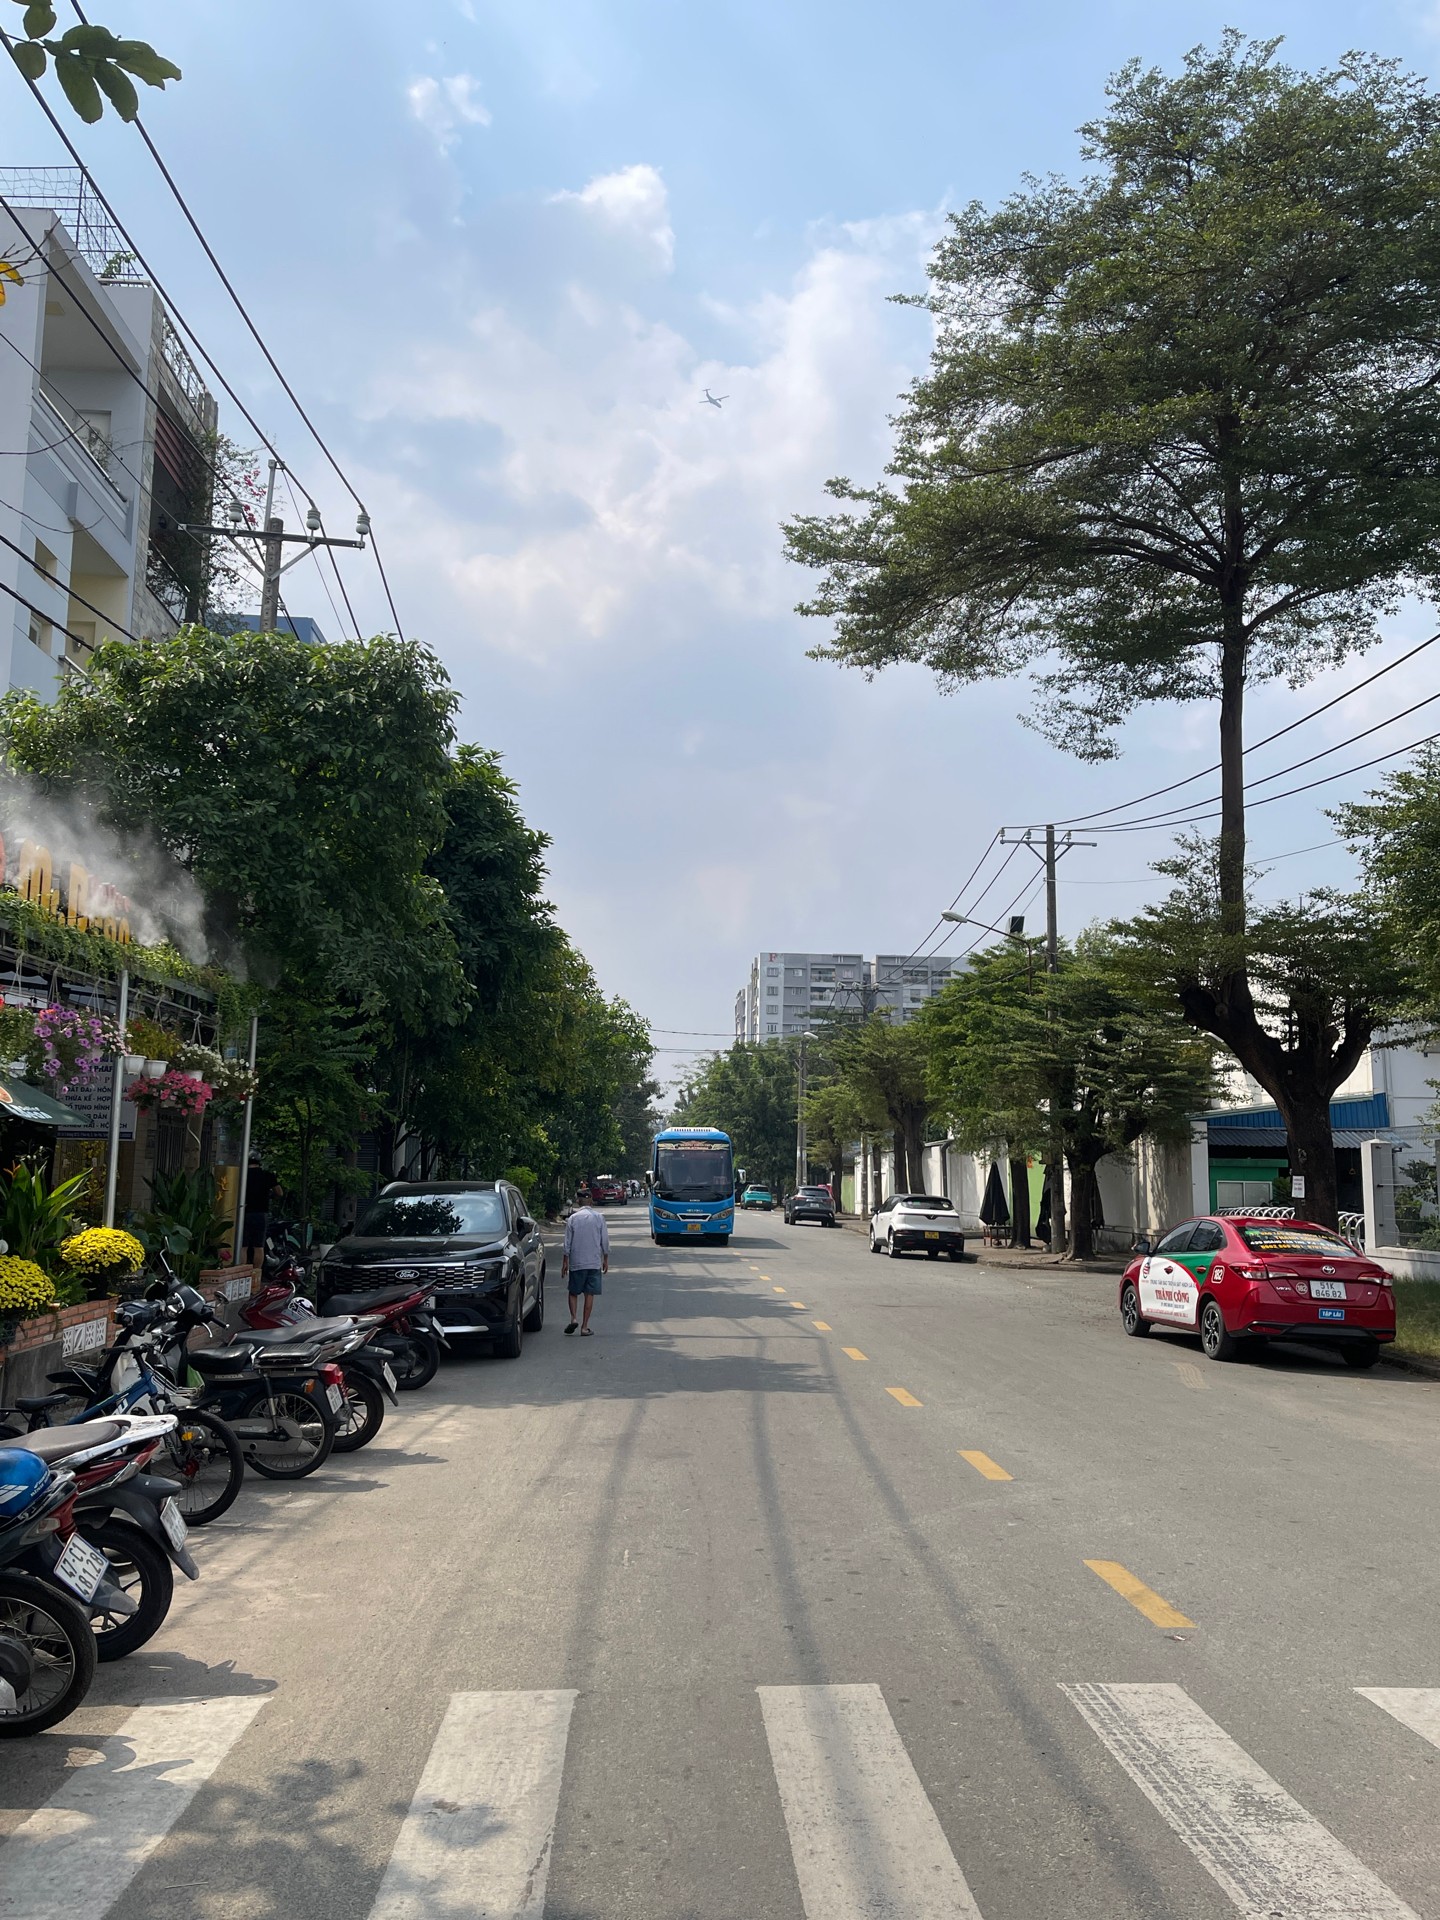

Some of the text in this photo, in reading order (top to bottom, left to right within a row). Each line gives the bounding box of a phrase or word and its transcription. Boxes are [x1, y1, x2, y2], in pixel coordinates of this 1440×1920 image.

[1213, 1268, 1223, 1281] 182
[1320, 1282, 1335, 1290] 51K
[1316, 1290, 1342, 1298] 846.82
